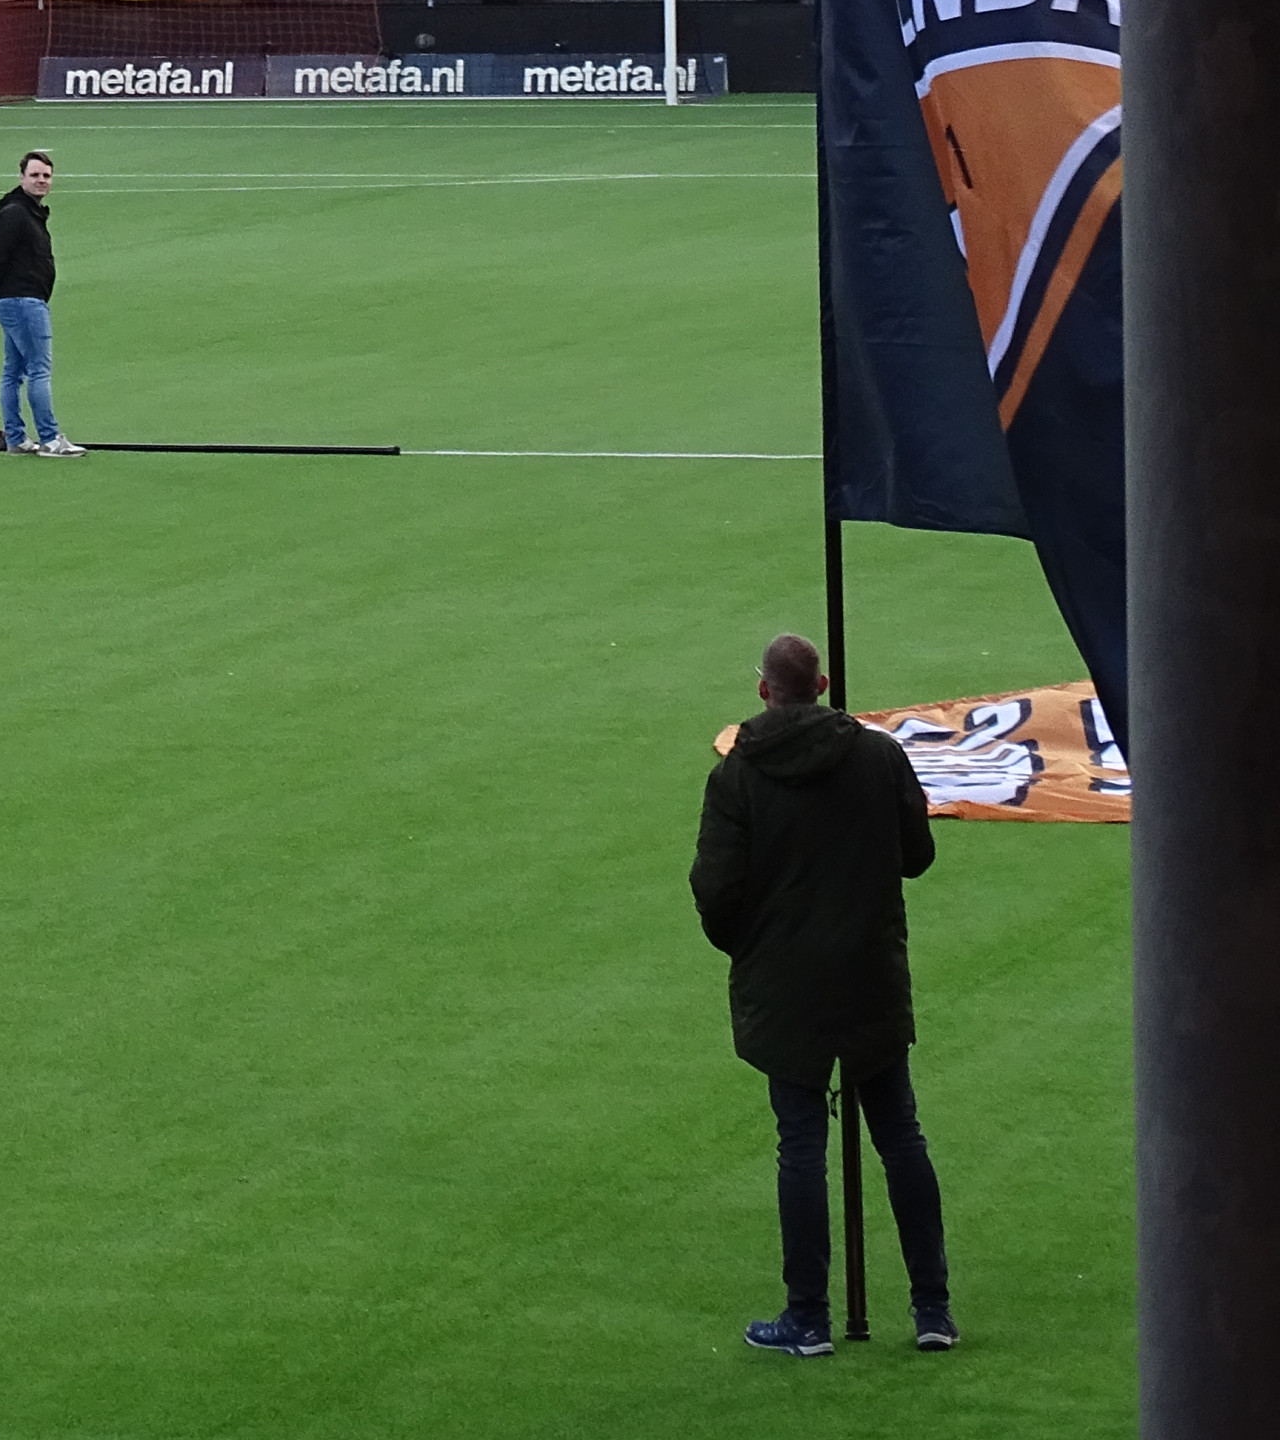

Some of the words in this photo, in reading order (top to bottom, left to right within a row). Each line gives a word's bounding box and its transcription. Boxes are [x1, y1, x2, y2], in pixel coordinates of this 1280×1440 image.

[65, 61, 234, 96] metafa.nl
[294, 59, 465, 94] metafa.nl
[522, 58, 697, 93] metafa.nl
